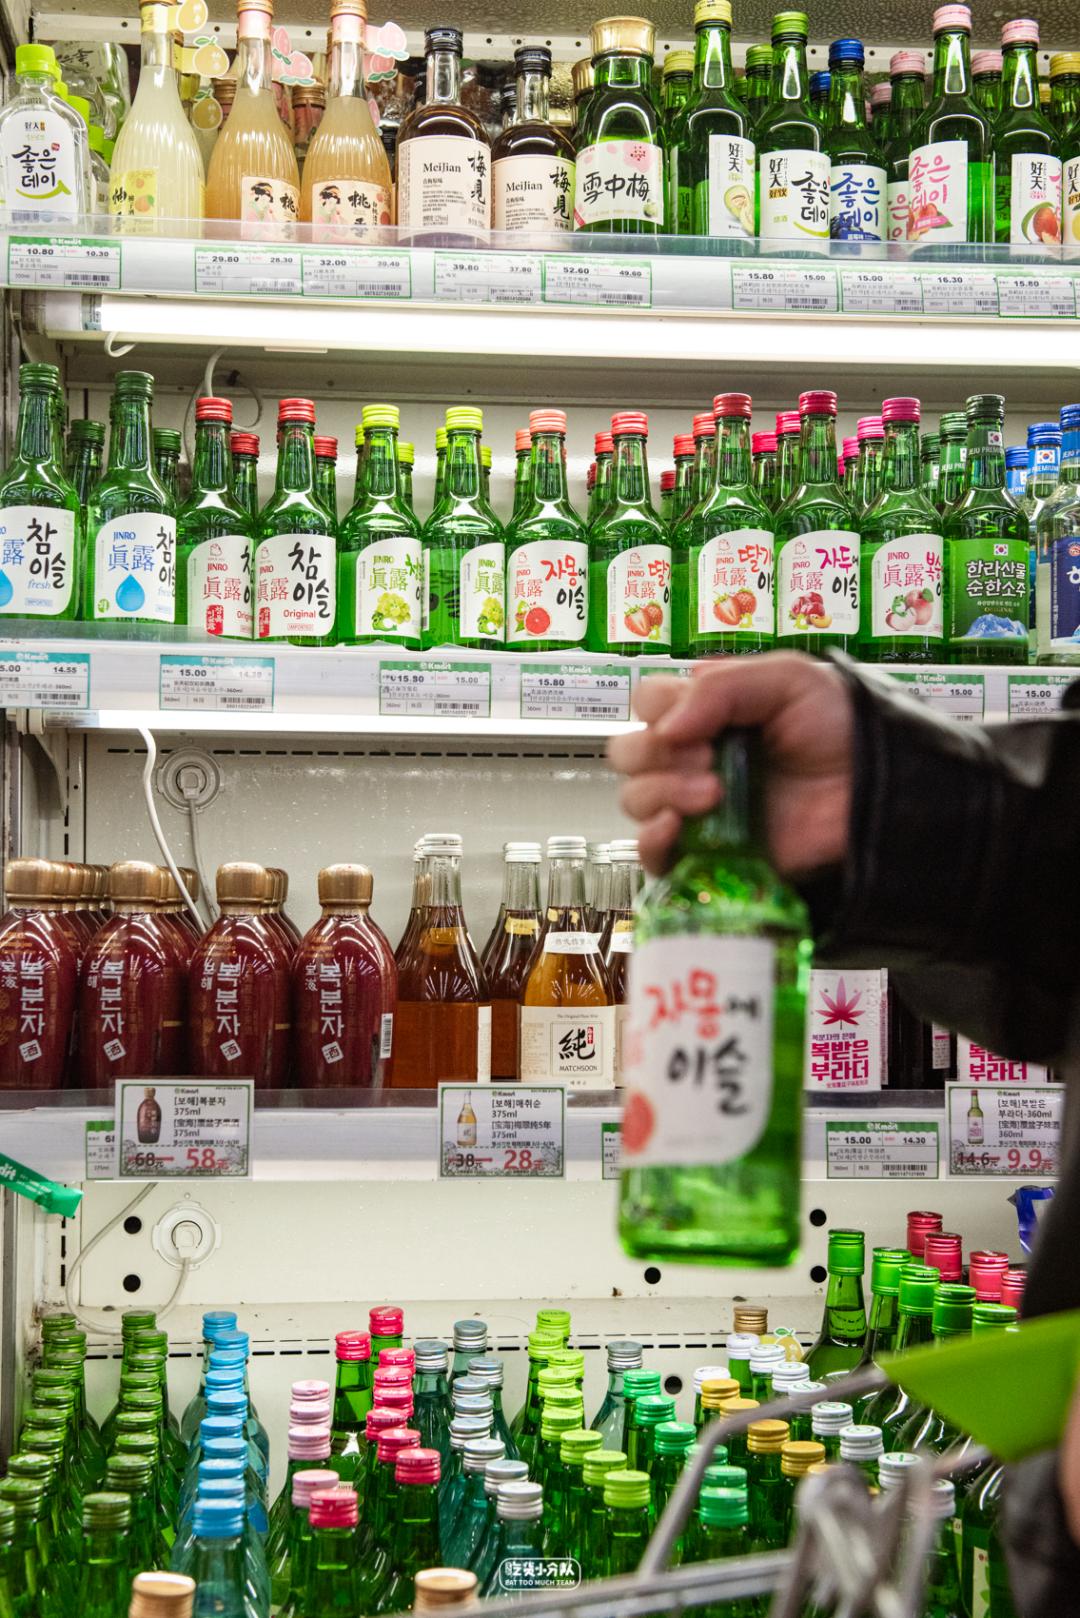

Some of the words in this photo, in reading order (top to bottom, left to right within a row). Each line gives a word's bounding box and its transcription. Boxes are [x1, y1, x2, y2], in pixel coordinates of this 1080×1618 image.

[12, 144, 57, 174] 좋은
[423, 162, 461, 173] MeiJian
[728, 142, 740, 172] 好天
[21, 171, 56, 189] 데이
[769, 158, 783, 188] 好天
[910, 154, 951, 193] 좋은
[1031, 161, 1042, 190] 好天
[506, 181, 543, 192] MeiJian
[583, 171, 650, 205] 雪中梅
[792, 171, 830, 205] 좋은
[831, 172, 880, 208] 좋은
[801, 206, 829, 226] 데이
[27, 517, 58, 555] 참
[114, 532, 136, 541] JINRO
[156, 526, 174, 563] 참
[2, 539, 25, 566] 露
[108, 545, 155, 571] 眞露
[288, 542, 322, 581] 참
[716, 556, 734, 565] JINRO
[738, 544, 774, 573] 딸기
[815, 545, 859, 574] 자두에
[888, 552, 910, 562] JINRO
[29, 552, 67, 590] 이슬
[207, 563, 228, 572] JINRO
[259, 565, 274, 575] JINRO
[516, 569, 531, 577] JINRO
[540, 554, 586, 587] 자몽에
[628, 568, 645, 578] JINRO
[792, 560, 811, 570] JINRO
[966, 560, 1026, 579] 한라산물
[28, 579, 51, 590] fresh
[713, 567, 747, 586] 眞露
[790, 572, 823, 592] 眞露
[883, 563, 924, 589] 眞露
[203, 576, 241, 600] 眞露
[257, 577, 289, 602] 眞露
[292, 578, 331, 619] 이슬
[514, 579, 543, 599] 眞露
[625, 580, 656, 599] 眞露
[832, 573, 858, 609] 이슬
[966, 578, 1026, 598] 순한소주
[556, 585, 586, 621] 이슬
[283, 609, 316, 620] Original
[180, 669, 207, 677] 15.00
[538, 679, 565, 687] 15.80
[1025, 690, 1051, 698] 15.00
[20, 960, 46, 1036] 복분자
[100, 960, 125, 1035] 복분자
[215, 962, 240, 1036] 복분자
[319, 963, 345, 1038] 복분자
[811, 1040, 869, 1061] 복받은
[667, 1034, 749, 1118] 이슬
[811, 1060, 869, 1081] 부라더
[969, 1061, 1027, 1081] 부라더
[174, 1107, 201, 1116] 375ml
[492, 1110, 518, 1118] 375ml
[173, 1129, 200, 1137] 375ml
[845, 1136, 872, 1144] 15.00
